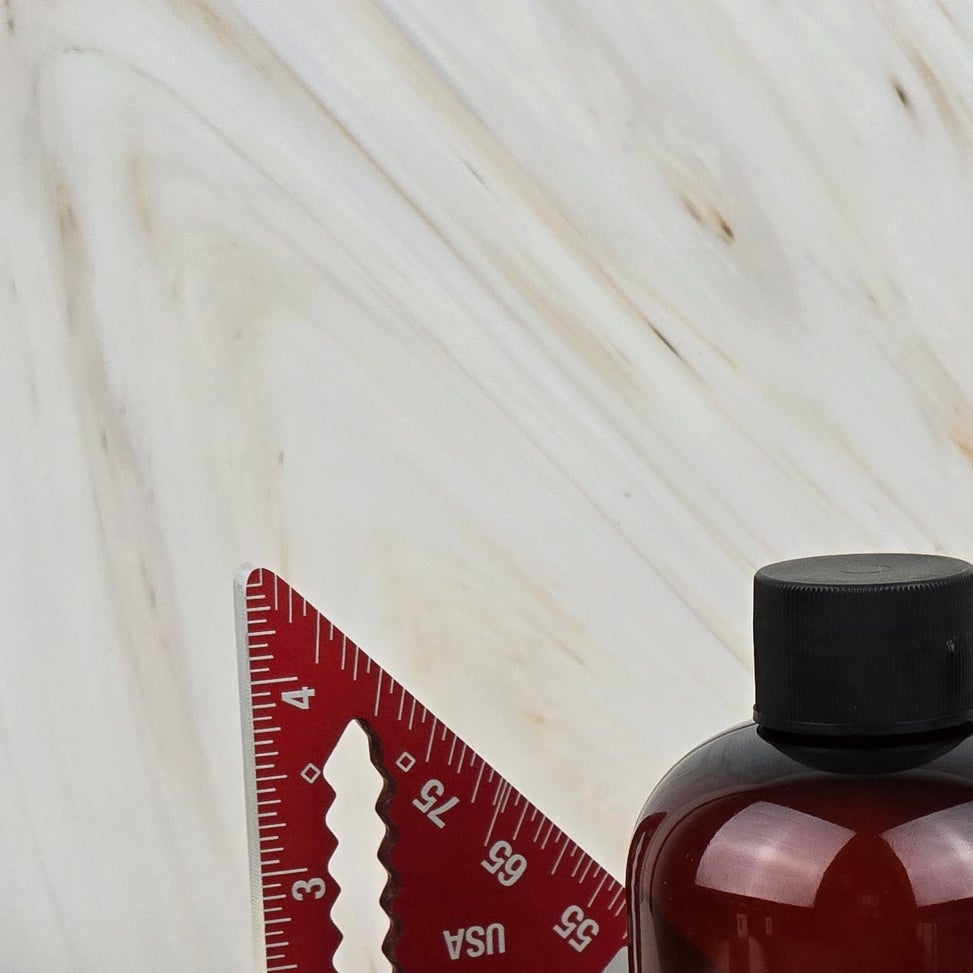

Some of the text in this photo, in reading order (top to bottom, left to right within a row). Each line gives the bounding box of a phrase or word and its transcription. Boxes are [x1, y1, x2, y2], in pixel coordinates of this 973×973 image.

[282, 687, 315, 709] 4
[413, 780, 459, 828] 75
[481, 840, 527, 886] 65
[292, 878, 325, 900] 3
[443, 922, 506, 960] USA
[553, 906, 599, 952] 55
